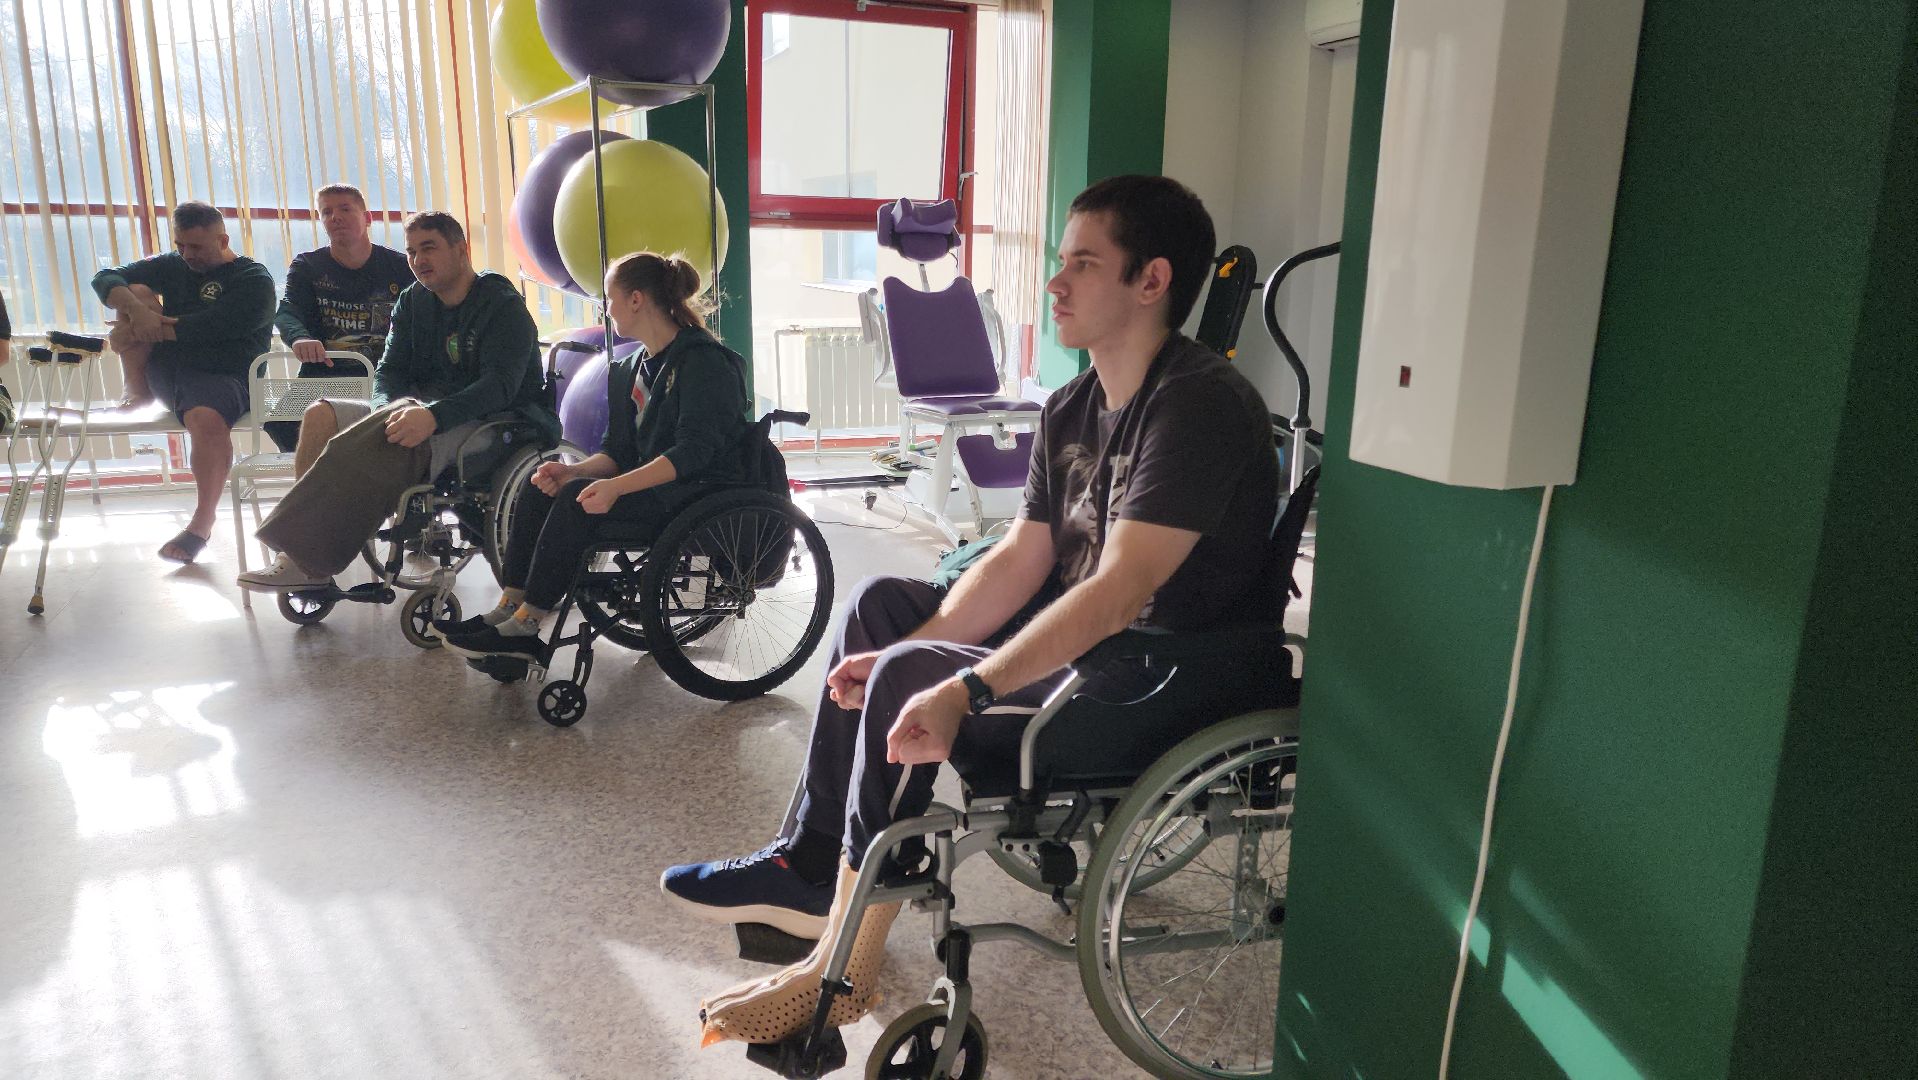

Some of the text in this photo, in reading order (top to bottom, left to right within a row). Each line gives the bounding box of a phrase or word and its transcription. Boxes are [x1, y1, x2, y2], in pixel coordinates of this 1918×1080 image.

[331, 300, 366, 311] THOSE
[323, 307, 358, 320] VALUE
[332, 316, 366, 330] TIME
